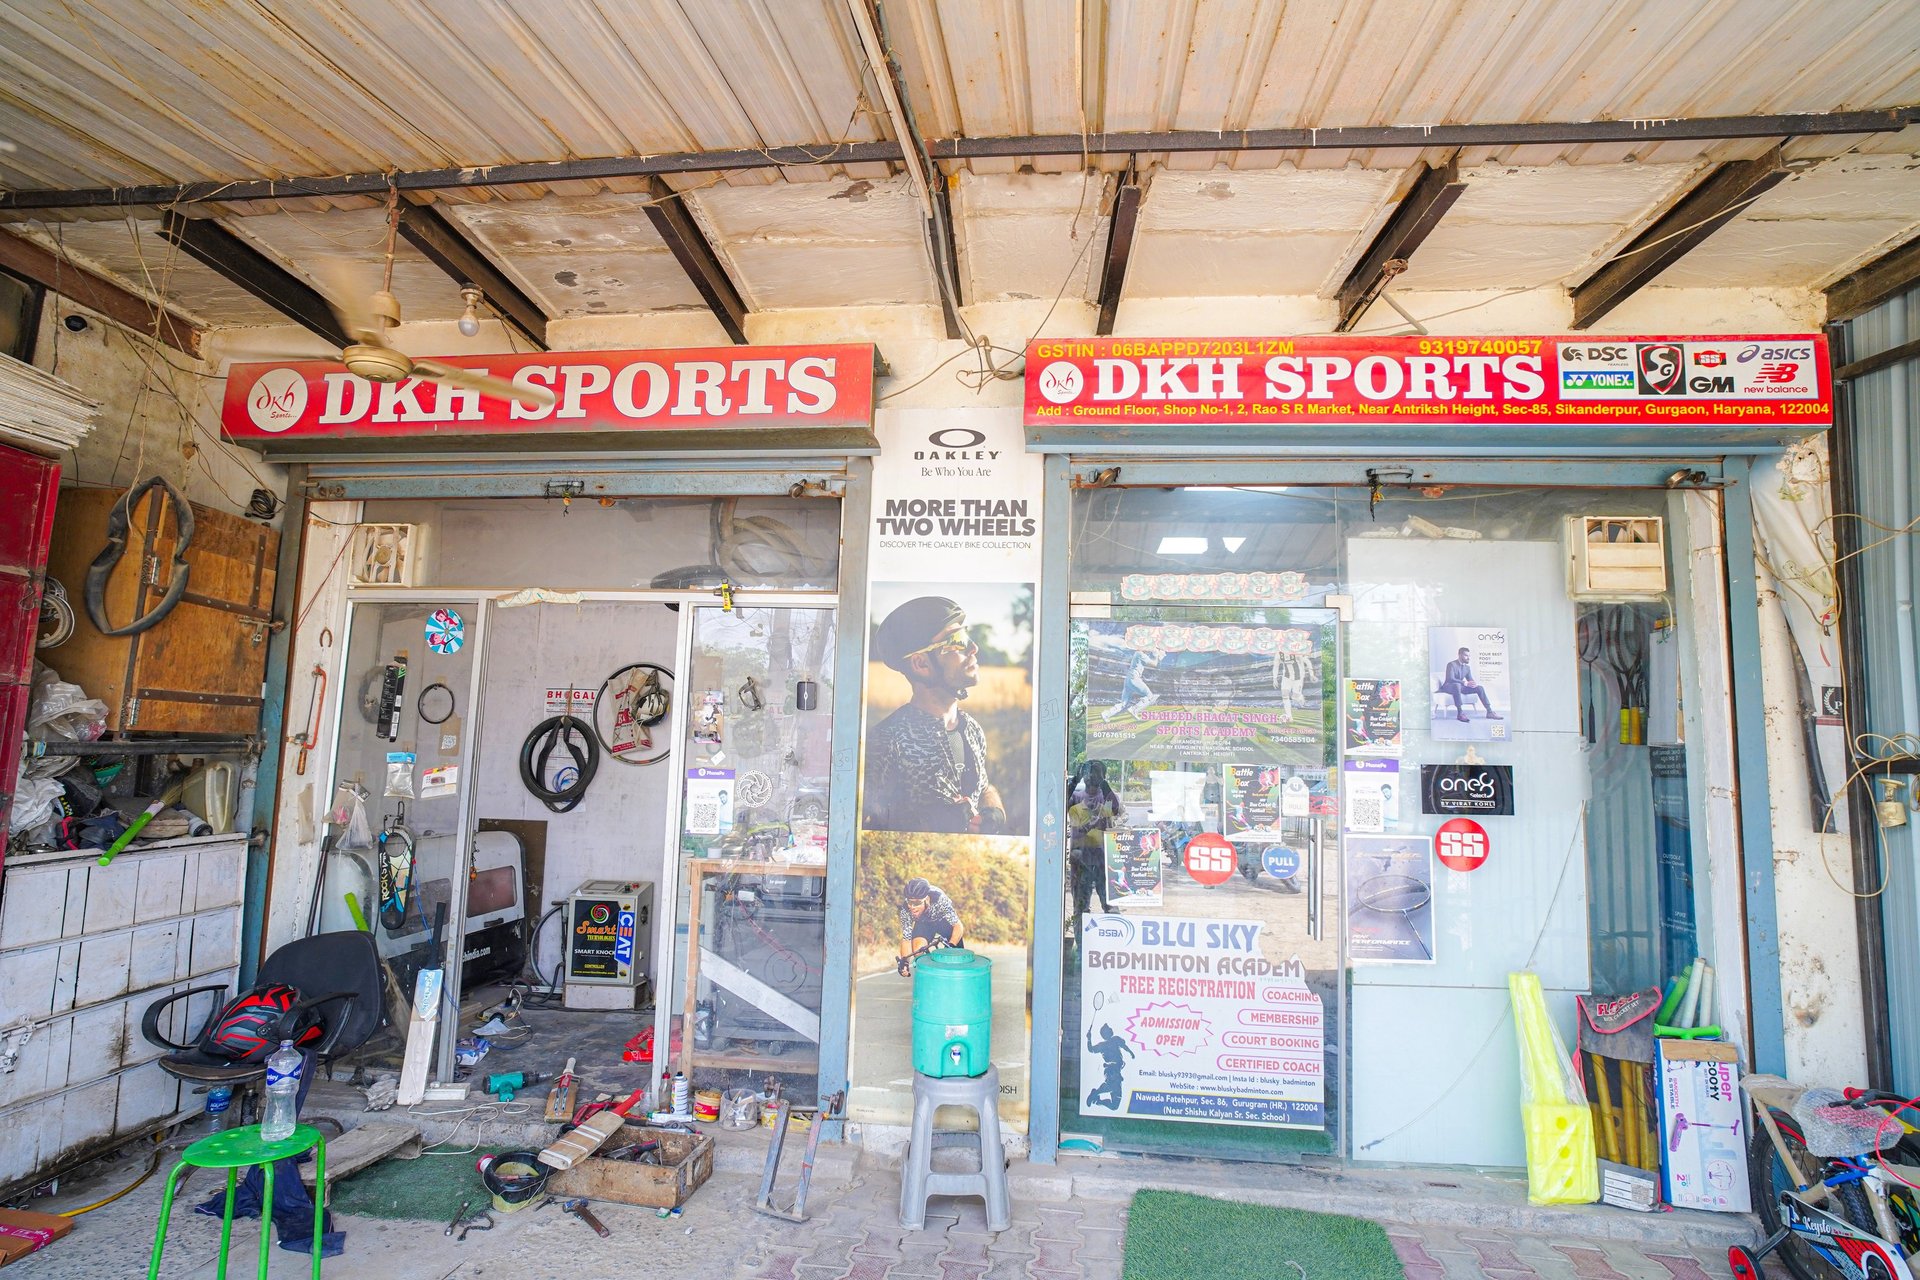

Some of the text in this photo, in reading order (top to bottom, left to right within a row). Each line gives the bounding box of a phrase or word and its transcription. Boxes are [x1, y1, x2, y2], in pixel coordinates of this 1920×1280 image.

[1037, 344, 1094, 358] GSTIN
[1111, 341, 1294, 357] 06BAPPD7203L1ZM
[1418, 340, 1543, 355] 9319740057
[1588, 346, 1628, 361] DSC
[1761, 348, 1811, 360] asics
[1700, 354, 1721, 364] SS
[1093, 355, 1545, 401] DKH SPORTS
[1689, 376, 1734, 393] GM
[319, 357, 838, 424] DKH SPORTS
[1036, 403, 1829, 417] Add Ground Floor, Shop No-1, 2, Rao S R Market, Near Antriksh Height, Sec-85, Sikanderpur, Gurgaon, Haryana, 122004
[913, 451, 999, 460] OAKLEY
[921, 467, 992, 477] Be Who You Are
[885, 499, 1028, 517] MORE THAN
[876, 518, 1036, 537] TWO WHEELS
[880, 541, 917, 549] DISCOVER
[934, 541, 963, 549] OAKLEY
[965, 541, 981, 549] BIKE
[982, 541, 1032, 549] COLLECTION
[1351, 681, 1374, 691] Battle
[1355, 692, 1370, 701] Box
[1141, 711, 1278, 723] SHAHEED BHAGAT SINGH
[1156, 726, 1200, 736] SPORTS
[1203, 727, 1257, 738] ACADEMY
[1231, 767, 1254, 776] Battle
[1235, 778, 1249, 787] Box
[1111, 832, 1134, 841] Battle
[1116, 843, 1130, 851] Box
[1440, 832, 1484, 858] SS
[1189, 846, 1231, 872] SS
[1268, 857, 1294, 866] PULL
[577, 920, 616, 934] Smart
[1098, 929, 1123, 937] BSBA
[617, 914, 633, 958] CEAT
[1142, 920, 1259, 953] BLU SKY
[1088, 950, 1210, 973] BADMINTON
[1120, 975, 1256, 1000] FREE REGISTRATION
[1267, 990, 1319, 1002] COACHING
[1141, 1016, 1201, 1030] ADMISSION
[1250, 1012, 1320, 1025] MEMBERSHIP
[1156, 1034, 1185, 1047] OPEN
[1231, 1034, 1320, 1049] COURT BOOKING
[1225, 1058, 1320, 1073] CERTIFIED COACH
[1139, 1069, 1157, 1077] Email:
[1158, 1070, 1228, 1081] blusky9393@gmail.com
[1169, 1082, 1284, 1096] WebSite www.bluskybadminton.com
[1135, 1092, 1318, 1112] Nawada Fatehpur, Sec. 86, Gurugram (HR.) 122004
[1163, 1106, 1183, 1116] (Near
[1184, 1108, 1208, 1117] Shishu
[1209, 1110, 1233, 1119] Kalyan
[1245, 1112, 1260, 1120] Sec.
[1261, 1112, 1286, 1122] School
